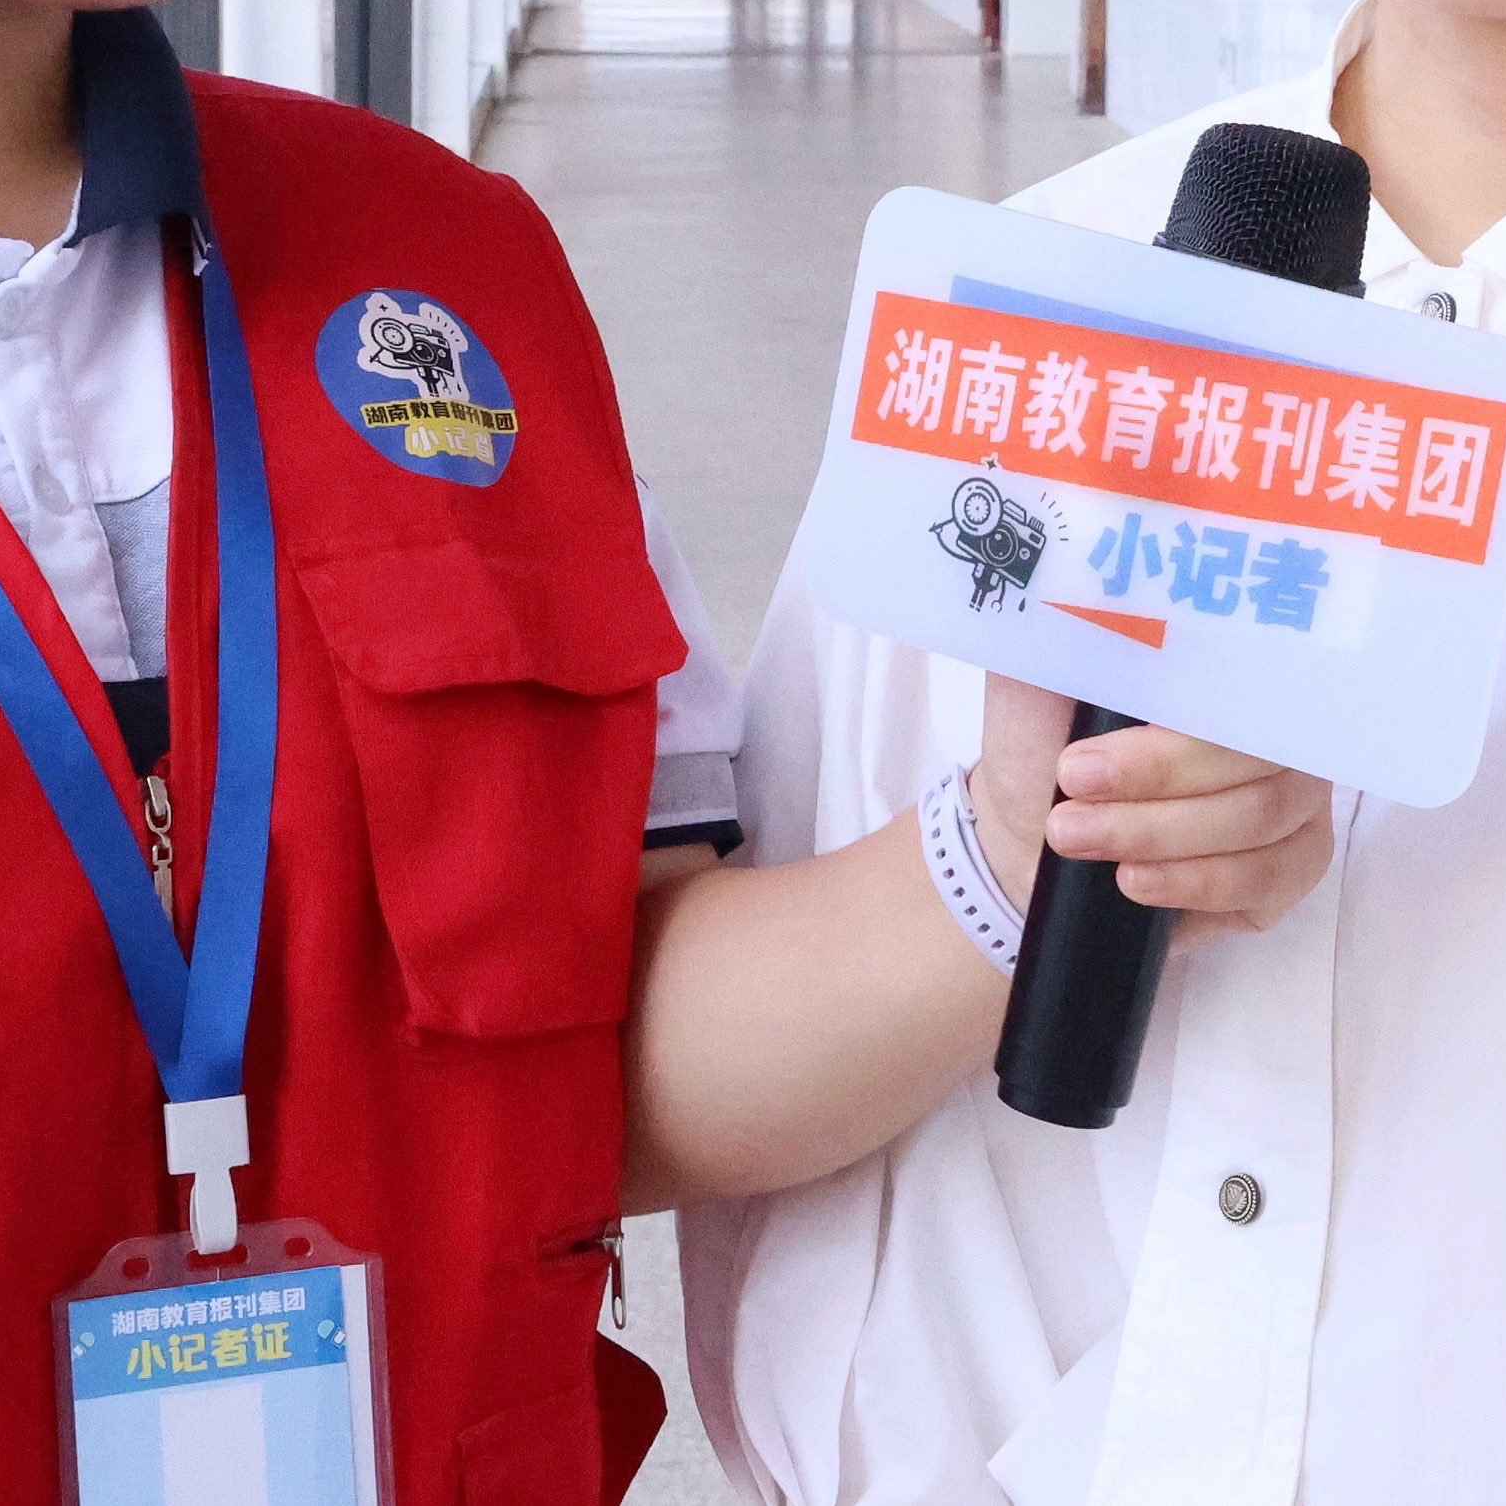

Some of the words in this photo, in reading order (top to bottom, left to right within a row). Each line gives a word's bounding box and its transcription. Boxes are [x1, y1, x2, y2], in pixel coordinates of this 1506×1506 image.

[876, 326, 1492, 527] 湖南教育报刊集团
[1087, 512, 1331, 633] 小记者
[111, 1287, 306, 1337] 湖南教育报刊集团
[126, 1321, 293, 1379] 小记者证
